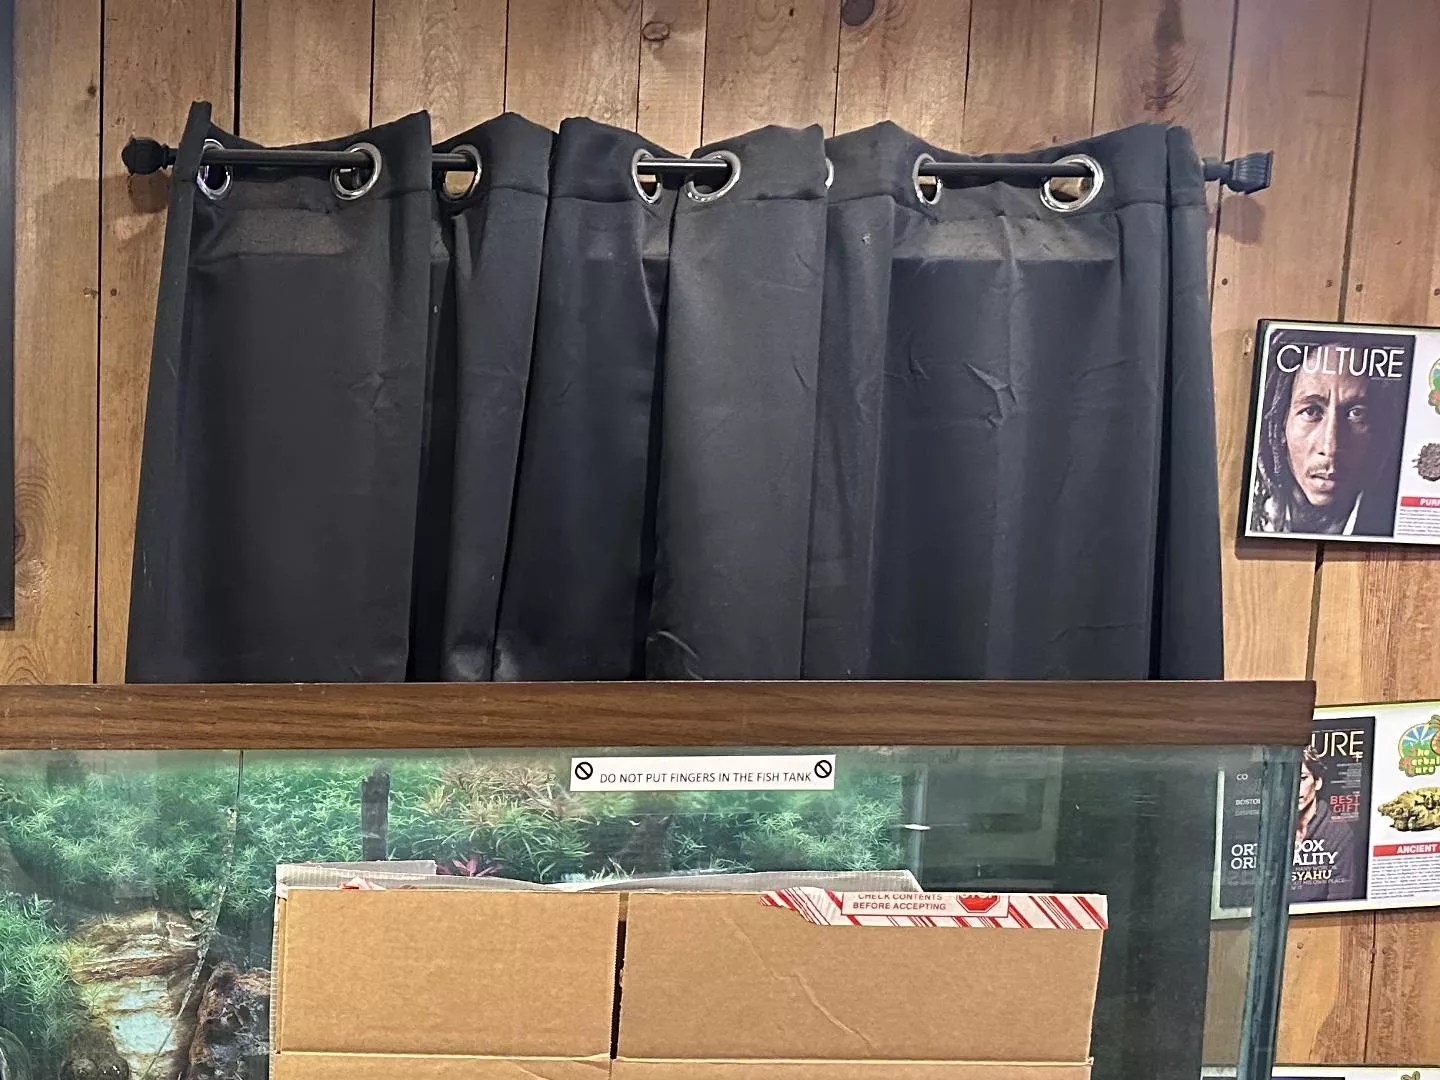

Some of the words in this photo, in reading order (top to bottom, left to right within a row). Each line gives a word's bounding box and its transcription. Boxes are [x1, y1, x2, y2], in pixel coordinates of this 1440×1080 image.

[1276, 344, 1405, 378] CULTURE
[600, 773, 616, 783] DO
[619, 773, 643, 783] NOT
[646, 773, 667, 783] PUT
[670, 772, 716, 783] FINGERS
[718, 772, 730, 782] IN
[733, 772, 754, 782] THE
[757, 772, 780, 782] FISH
[782, 771, 812, 782] TANK
[1330, 794, 1360, 805] BEST
[1333, 803, 1360, 813] GIFT
[1396, 844, 1438, 855] ANCIENT
[852, 902, 891, 910] BEFORE
[892, 903, 947, 911] ACCEPTING
